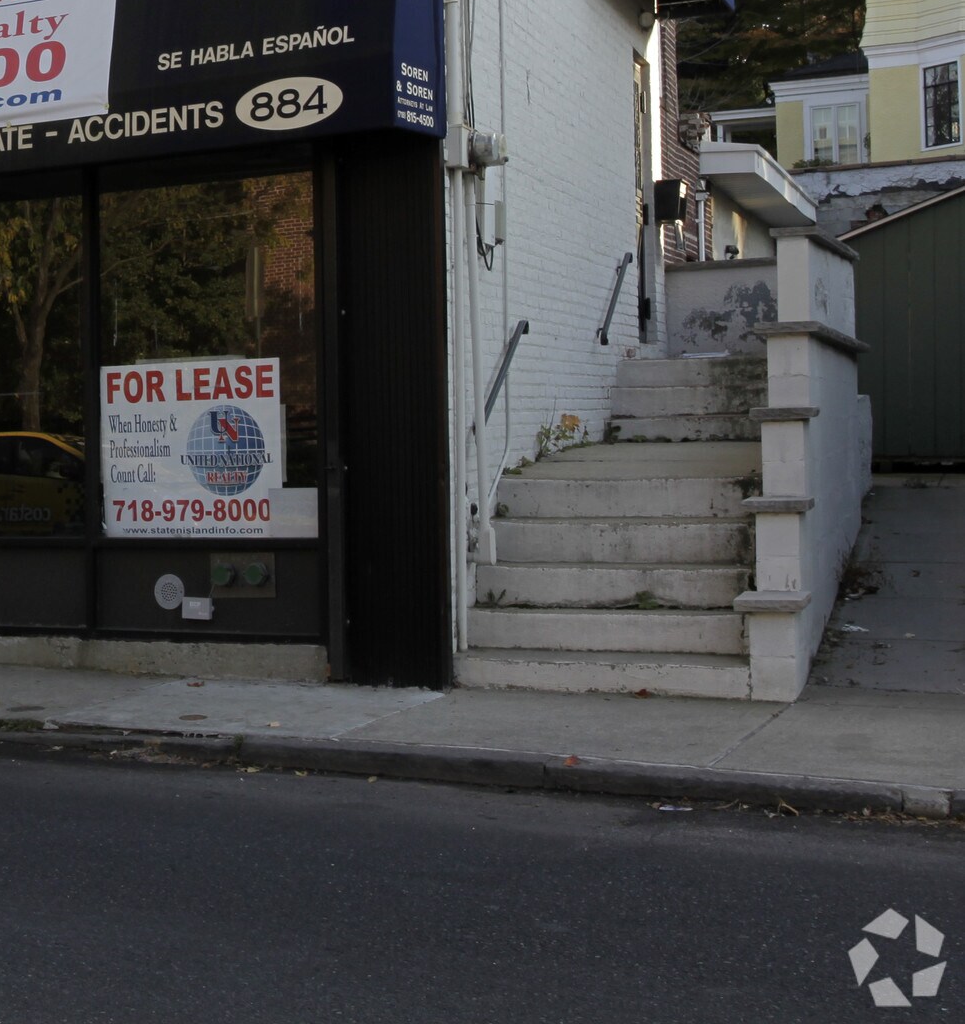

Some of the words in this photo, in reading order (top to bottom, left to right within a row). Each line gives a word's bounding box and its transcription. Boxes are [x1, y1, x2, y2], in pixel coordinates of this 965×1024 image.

[157, 51, 182, 71] SE
[190, 41, 254, 66] HABLA
[262, 25, 355, 55] ESPAÑOL
[396, 80, 402, 92] &
[250, 85, 328, 122] 884
[67, 101, 225, 144] ACCIDENTS
[406, 110, 434, 128] 815-4500
[106, 371, 166, 404] FOR
[175, 364, 274, 401] LEASE
[108, 415, 132, 433] When
[134, 414, 167, 438] Honesty
[169, 413, 177, 431] &
[109, 438, 171, 458] Professionalism
[180, 454, 218, 466] UNITED
[220, 453, 273, 466] NATIONAL
[110, 464, 135, 483] Count
[137, 463, 156, 483] Call:
[207, 471, 247, 483] REALTY
[113, 498, 271, 522] 718-979-8000
[123, 526, 264, 535] www.statenislandinfo.com
